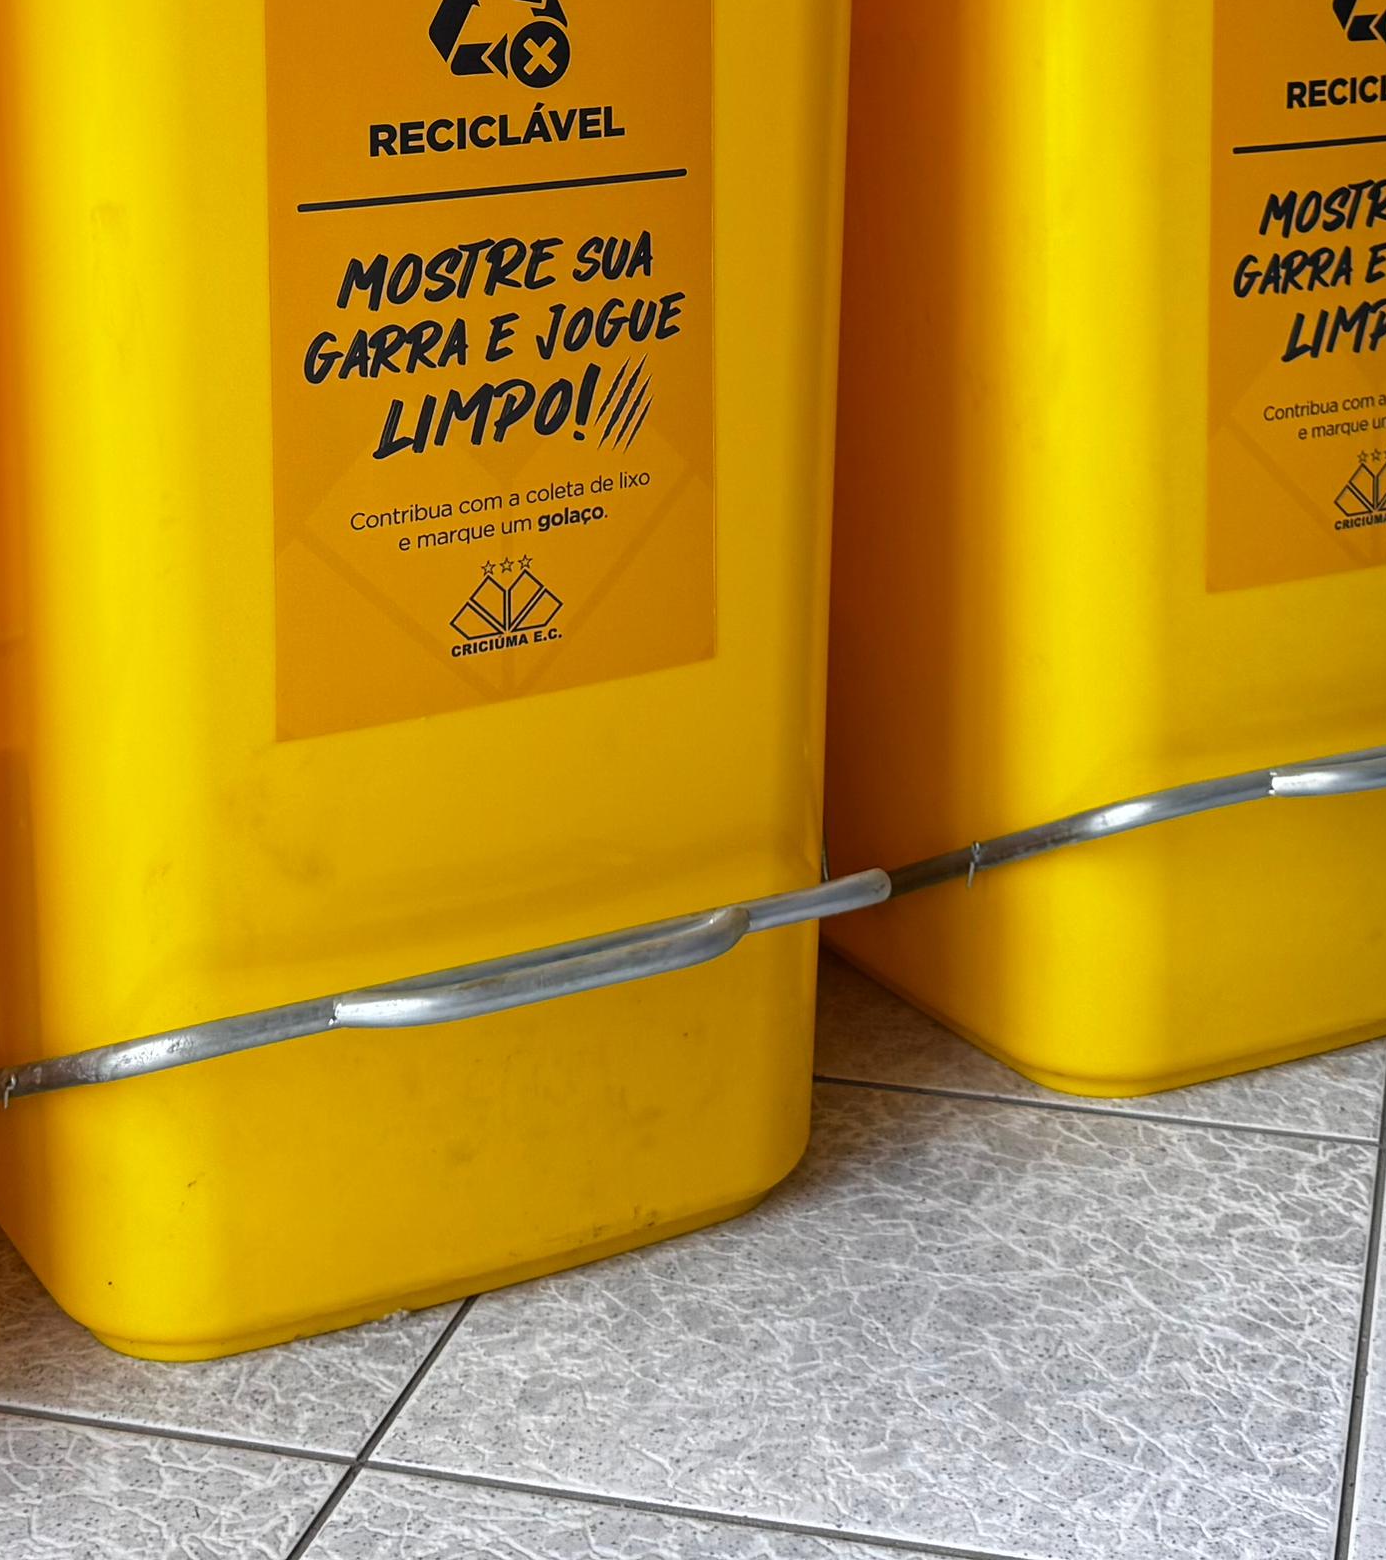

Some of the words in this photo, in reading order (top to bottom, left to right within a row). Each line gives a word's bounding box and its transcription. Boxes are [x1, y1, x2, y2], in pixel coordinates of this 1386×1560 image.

[369, 102, 625, 157] RECICLÁVEL
[336, 237, 564, 312] MOSTRE
[572, 230, 653, 282] SUA
[1233, 246, 1352, 298] GARRA
[303, 318, 469, 384] GARRA
[485, 313, 520, 362] E
[535, 291, 686, 360] JOGUE
[372, 363, 602, 460] LIMPO!
[1263, 397, 1338, 422] Contribua
[1342, 392, 1374, 411] com
[1378, 393, 1386, 406] a
[1298, 426, 1308, 440] e
[1312, 416, 1369, 440] marque
[350, 502, 452, 531] Contribua
[459, 494, 502, 515] com
[508, 492, 520, 506] a
[526, 479, 584, 504] coleta
[590, 476, 614, 494] de
[619, 471, 650, 489] lixo
[398, 537, 411, 552] e
[417, 523, 495, 548] marque
[501, 518, 532, 535] um
[537, 504, 608, 532] golaço.
[451, 634, 528, 658] CRICIÚMA
[533, 628, 563, 644] E.C.
